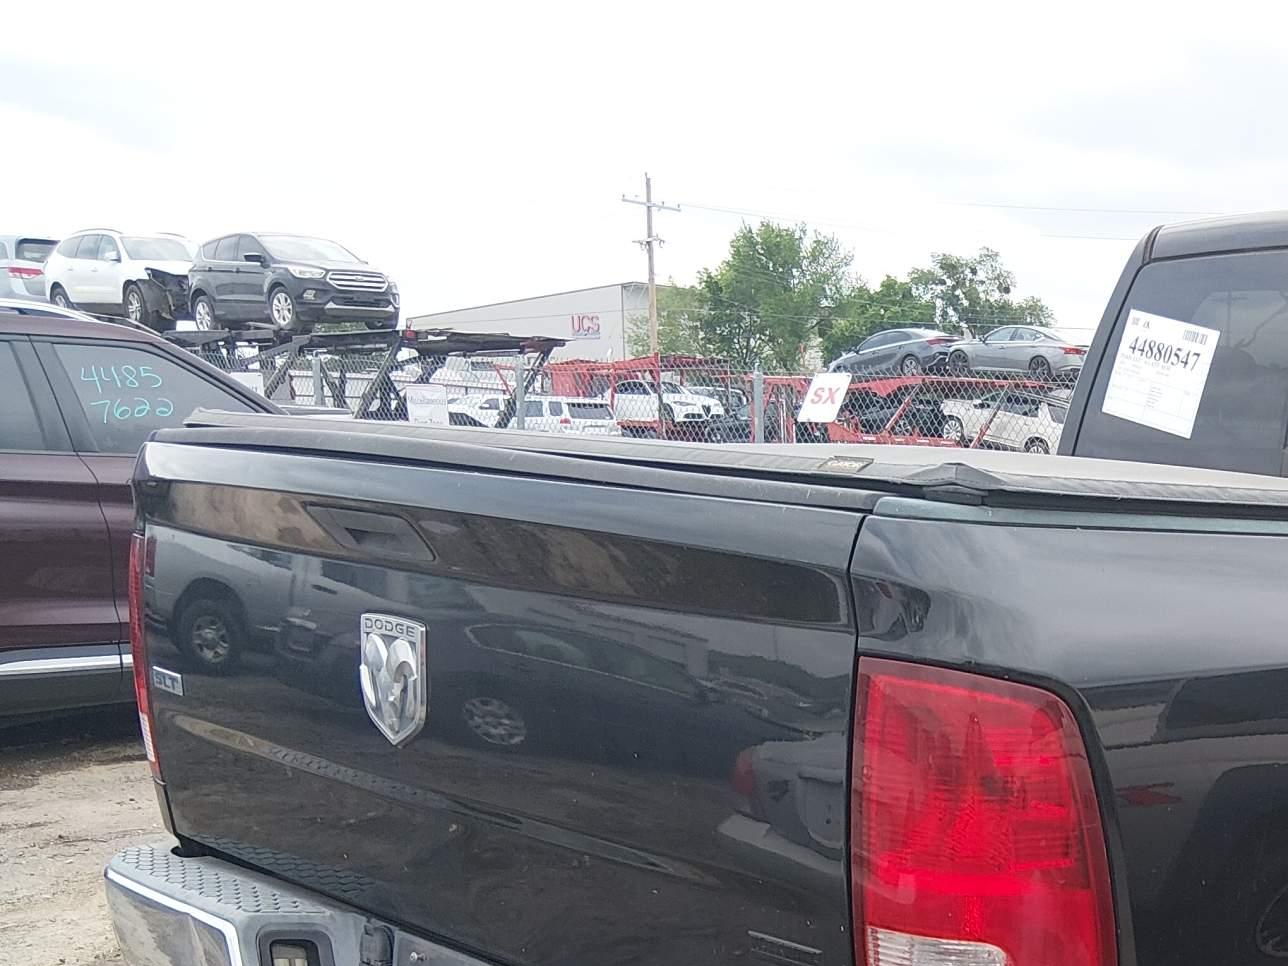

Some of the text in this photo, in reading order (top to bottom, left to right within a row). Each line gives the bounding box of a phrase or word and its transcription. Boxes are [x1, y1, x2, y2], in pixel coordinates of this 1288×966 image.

[571, 314, 600, 333] UCS
[1128, 336, 1201, 371] 44880547
[80, 364, 163, 393] 4485
[810, 386, 841, 405] SX
[89, 397, 174, 424] 7622
[364, 617, 416, 638] DODGE
[154, 672, 179, 691] SLT
